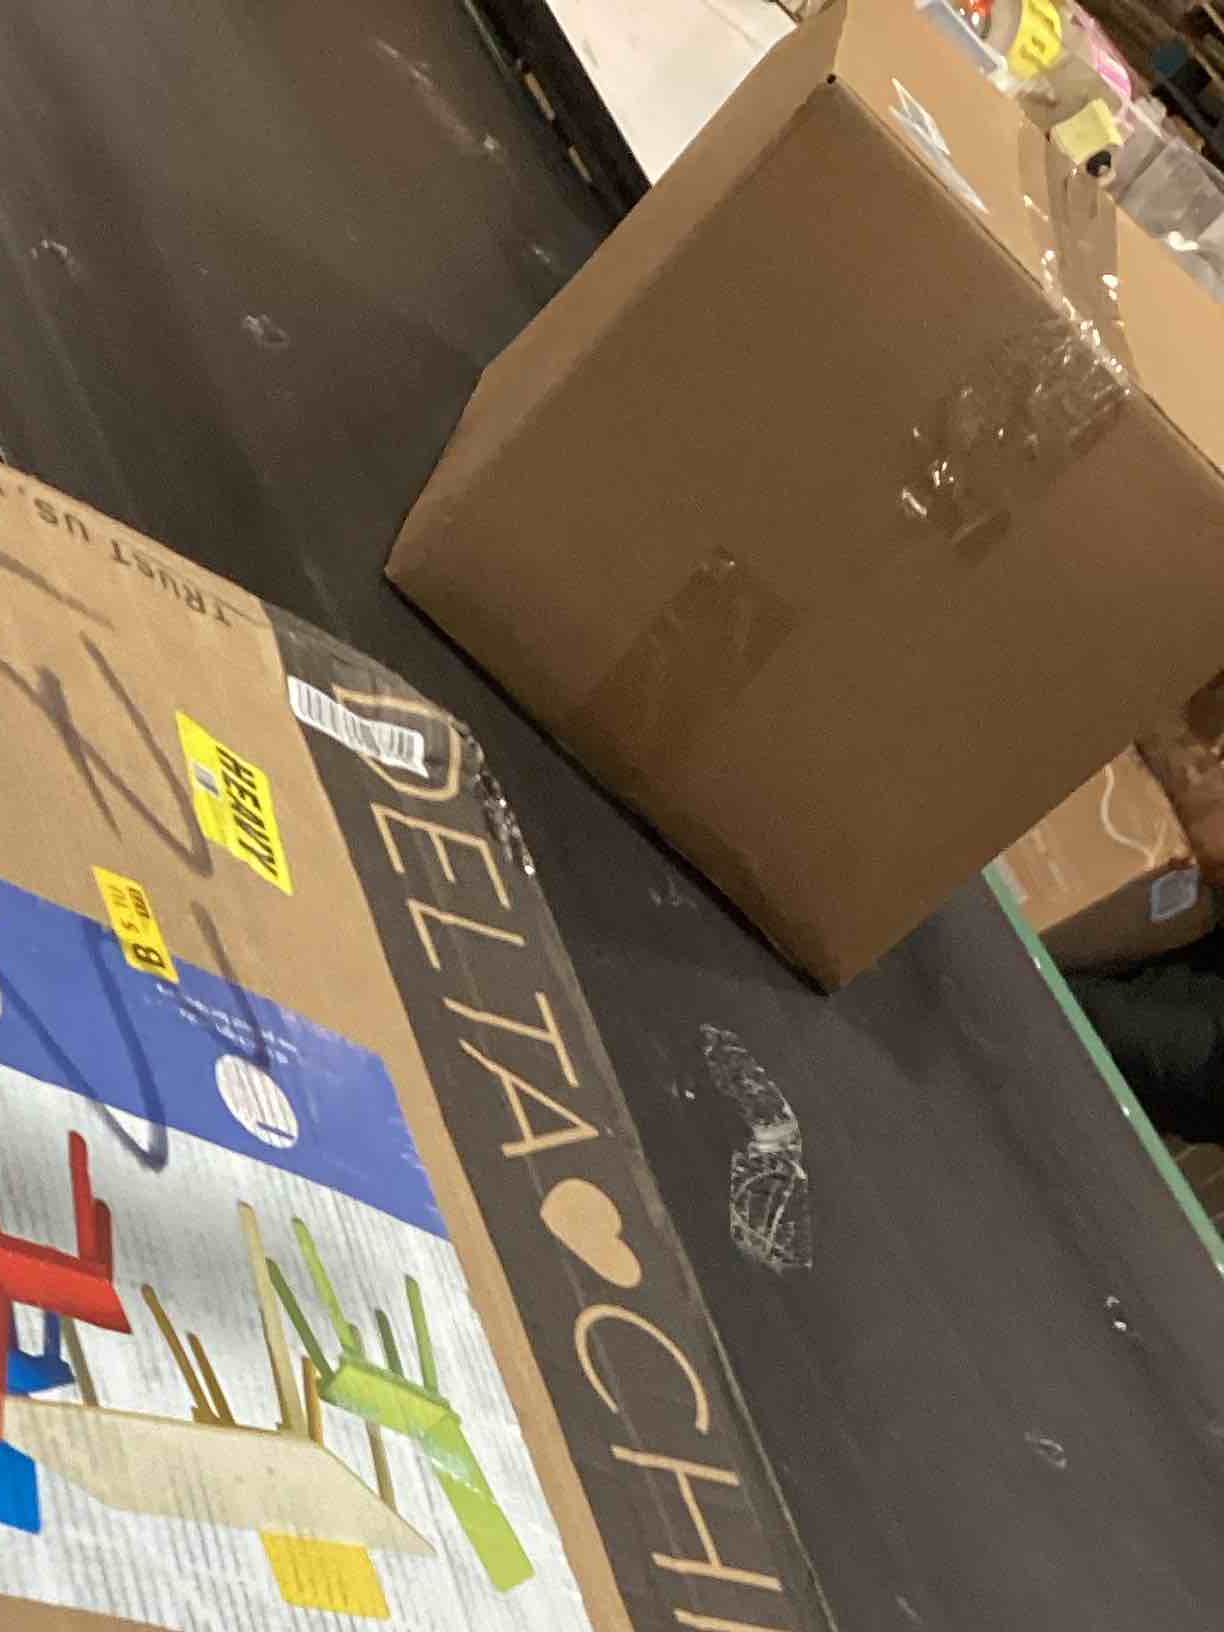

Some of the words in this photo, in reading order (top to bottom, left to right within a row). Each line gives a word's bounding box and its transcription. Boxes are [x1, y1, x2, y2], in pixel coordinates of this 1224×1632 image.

[110, 537, 232, 628] TRUST
[215, 744, 280, 878] HEAVY
[332, 683, 599, 1159] DELTA
